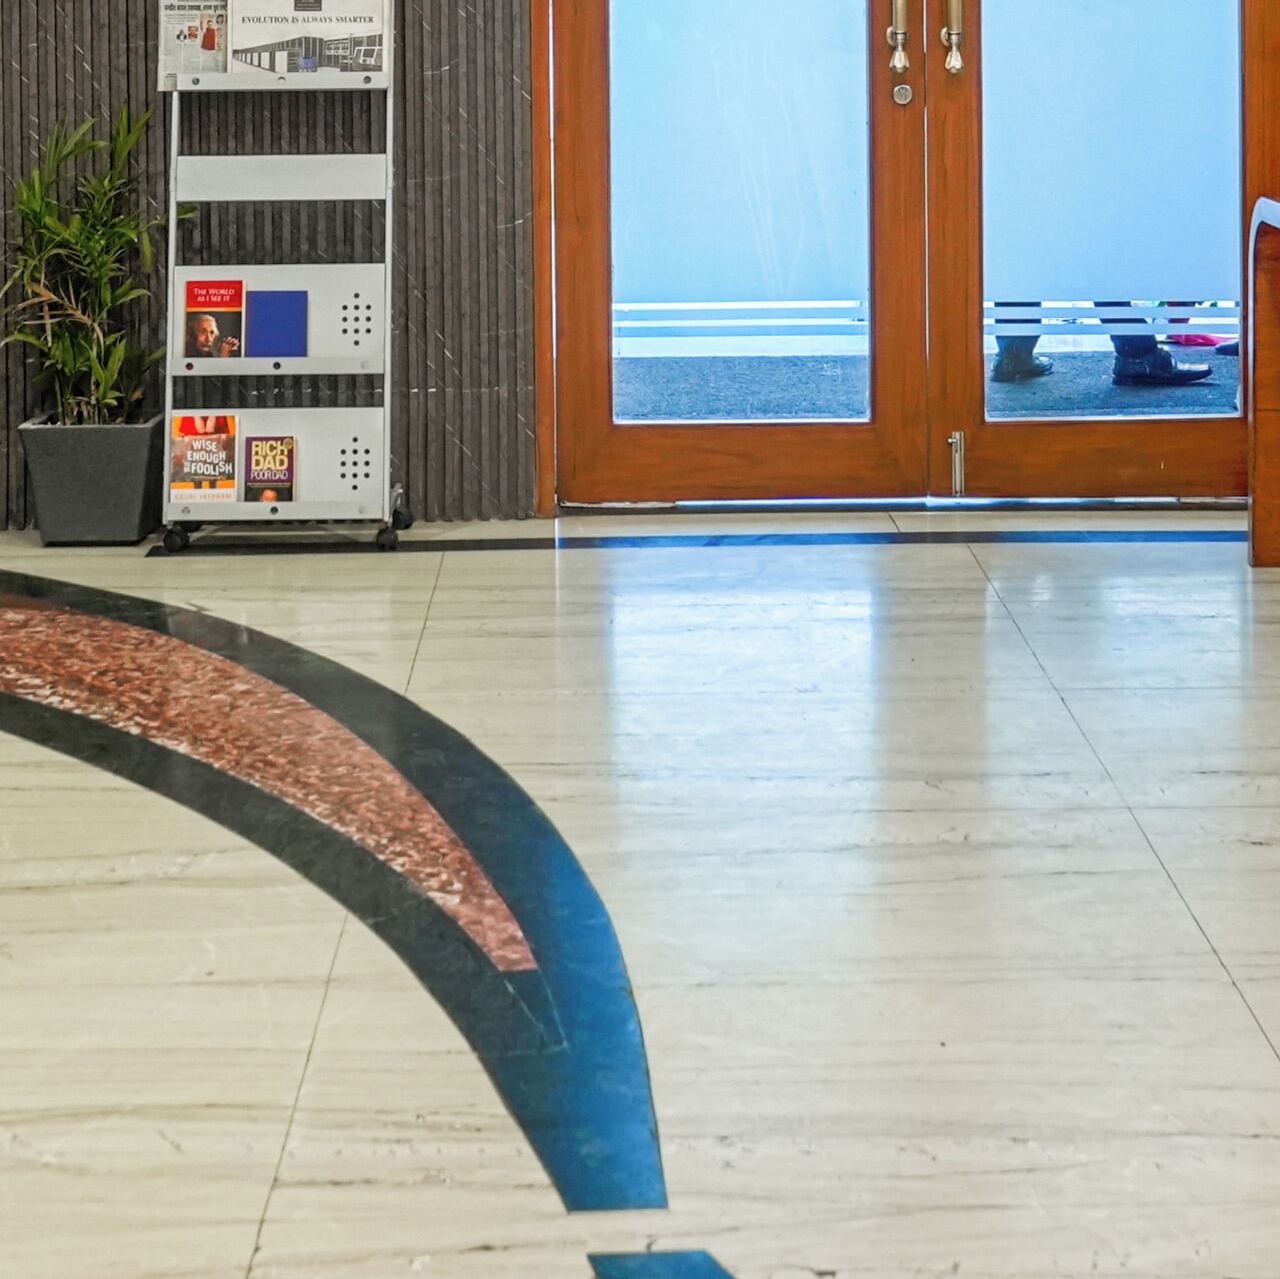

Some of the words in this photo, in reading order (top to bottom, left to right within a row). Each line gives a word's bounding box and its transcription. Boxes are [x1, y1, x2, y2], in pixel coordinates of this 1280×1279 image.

[241, 16, 289, 24] EVOLUTION
[291, 16, 300, 24] IS
[301, 16, 333, 24] ALWAYS
[334, 16, 374, 24] SMARTER
[193, 288, 207, 296] THE
[208, 288, 235, 296] WORLD
[192, 438, 218, 452] WISE
[252, 440, 289, 456] RICH
[186, 450, 226, 464] ENOUGH
[252, 455, 289, 470] DAD
[191, 461, 233, 476] FOOLISH
[251, 470, 272, 480] POOR
[272, 470, 289, 480] DAD
